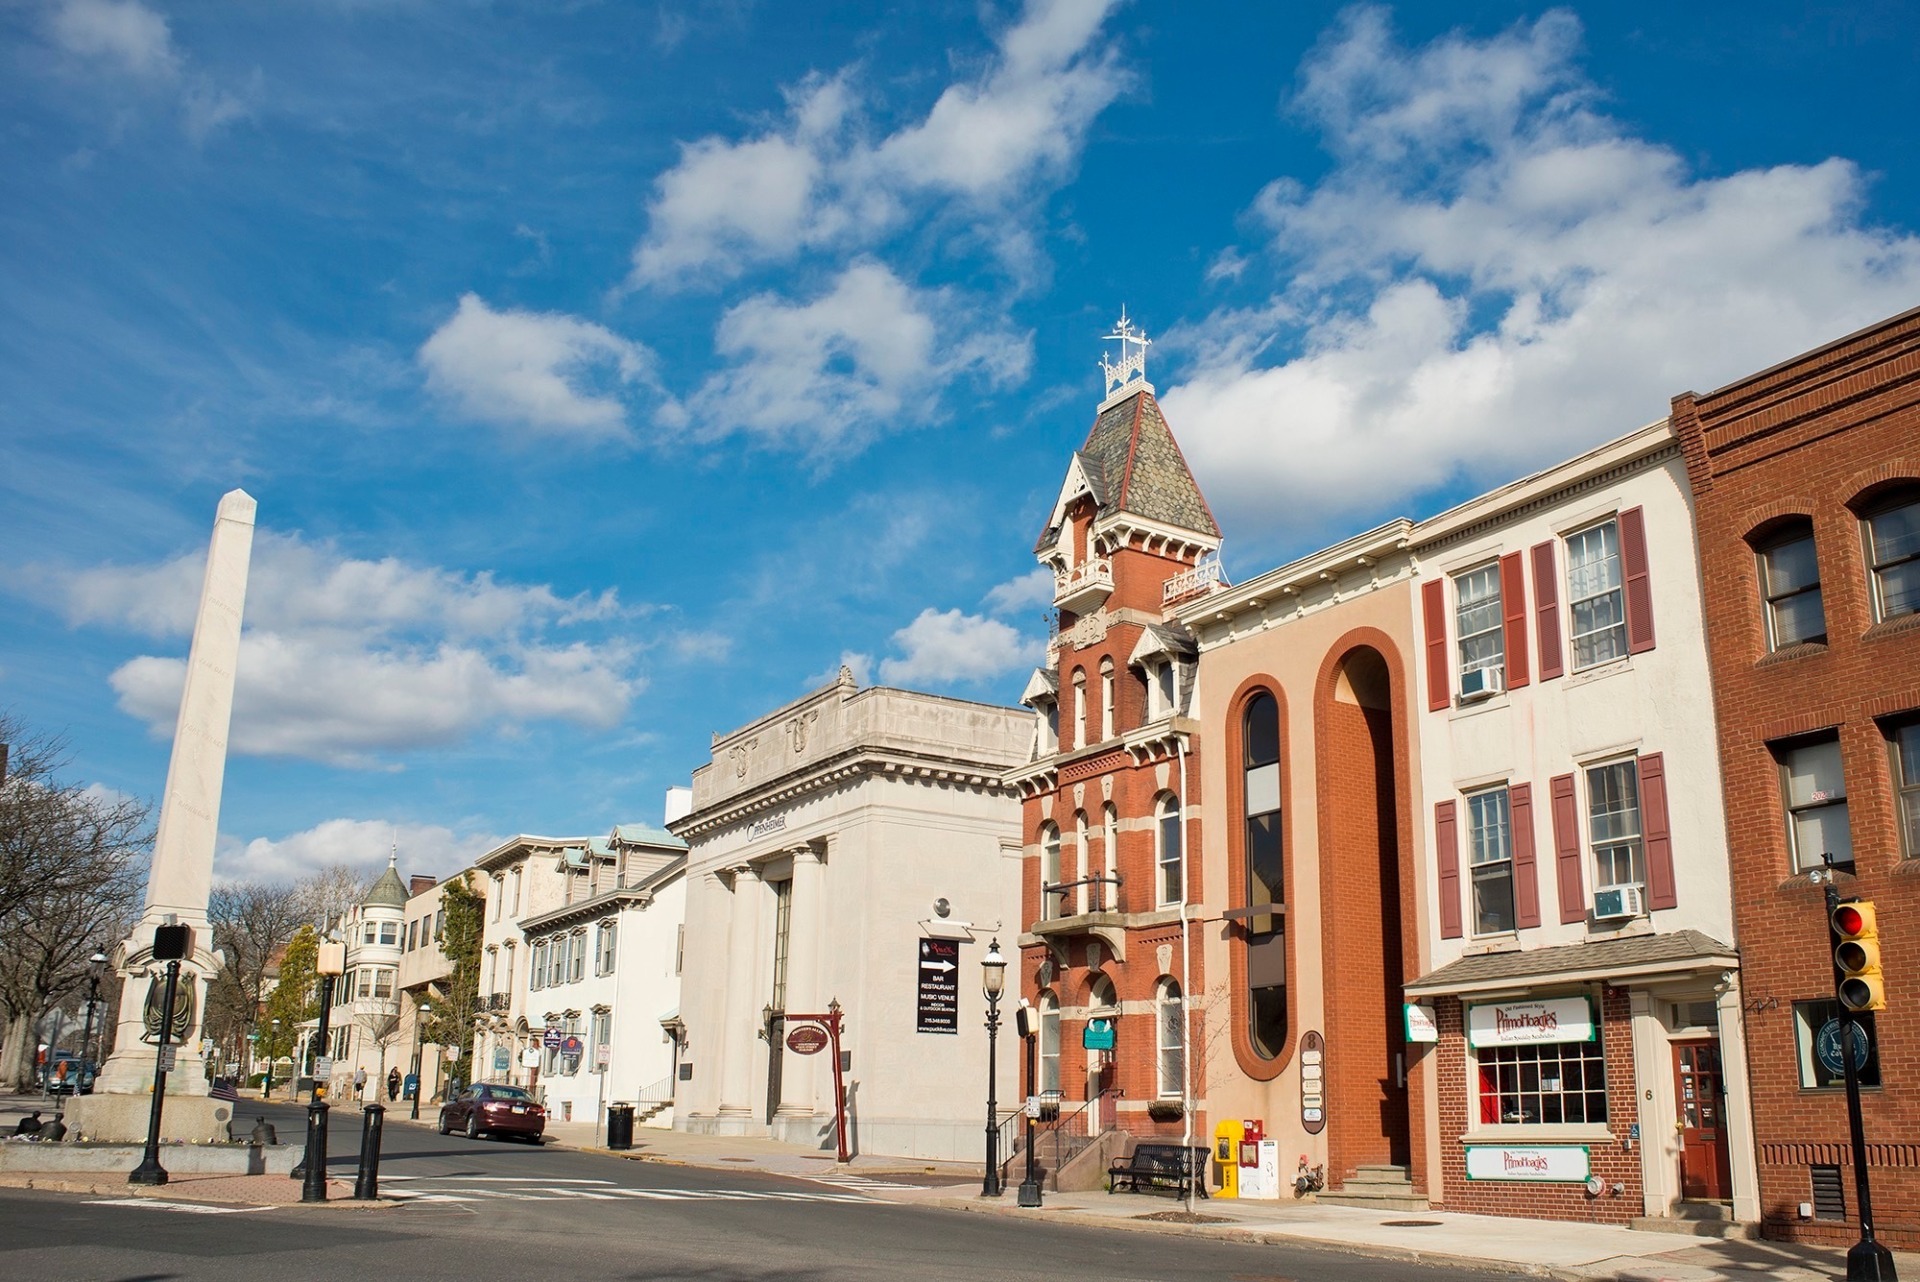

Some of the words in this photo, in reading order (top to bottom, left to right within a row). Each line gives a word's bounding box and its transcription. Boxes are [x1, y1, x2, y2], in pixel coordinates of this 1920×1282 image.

[747, 816, 787, 842] OPPENHEIMER
[1496, 1007, 1557, 1035] PrimoHoagies
[1308, 1034, 1316, 1049] 8
[1645, 1090, 1653, 1100] 6
[1504, 1151, 1548, 1171] PrimoHoagies
